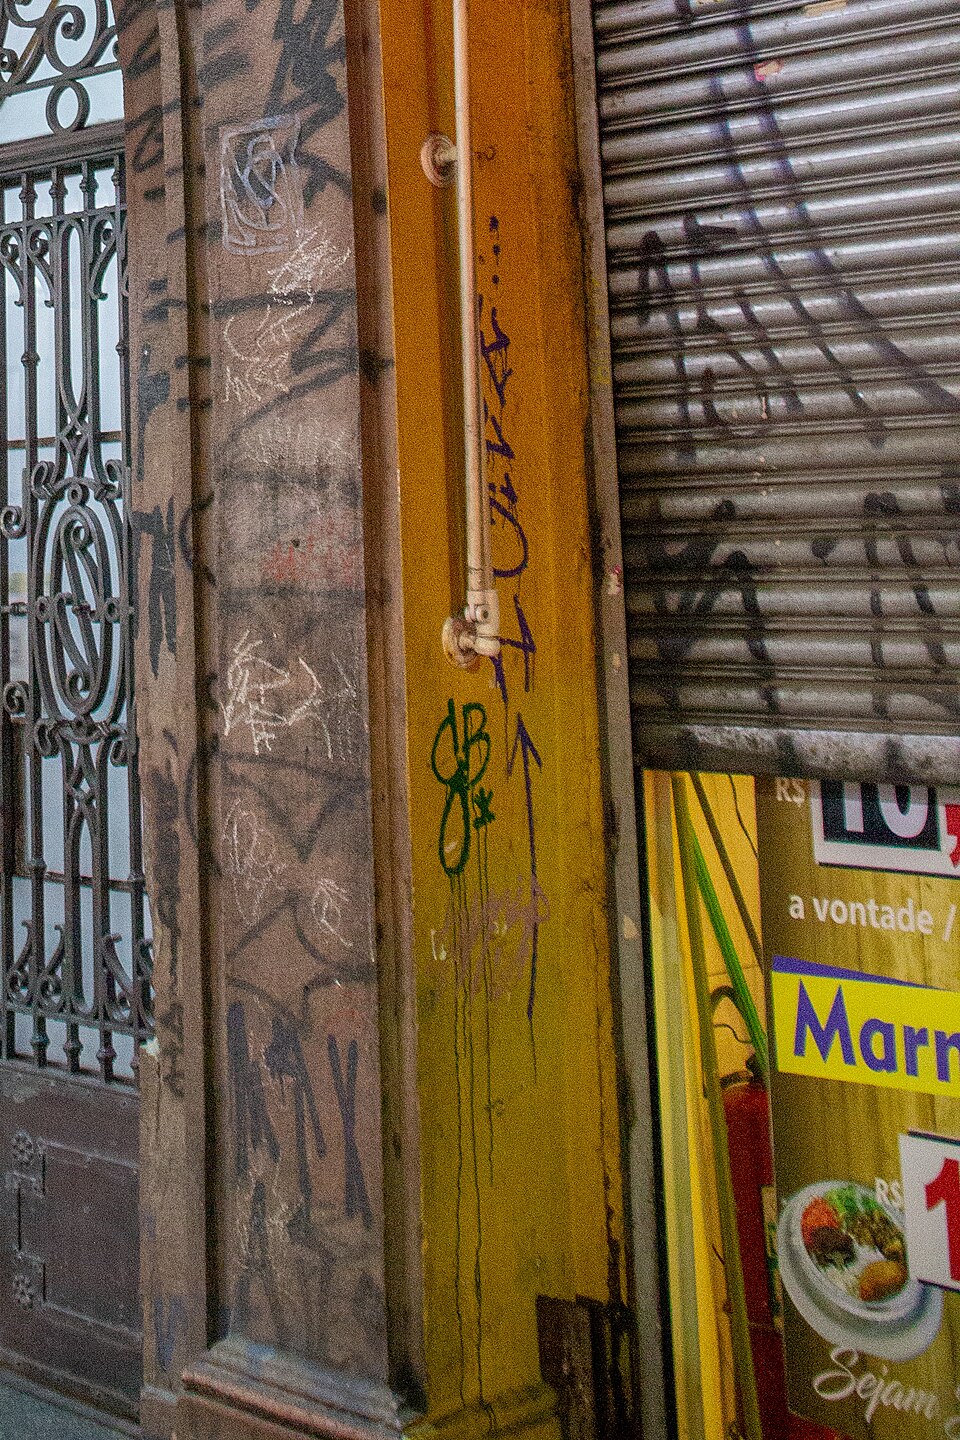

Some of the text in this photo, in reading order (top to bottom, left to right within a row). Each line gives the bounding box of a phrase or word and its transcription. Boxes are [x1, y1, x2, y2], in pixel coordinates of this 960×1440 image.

[790, 895, 805, 920] a
[813, 898, 934, 935] vontade
[813, 1346, 938, 1423] Sejam
